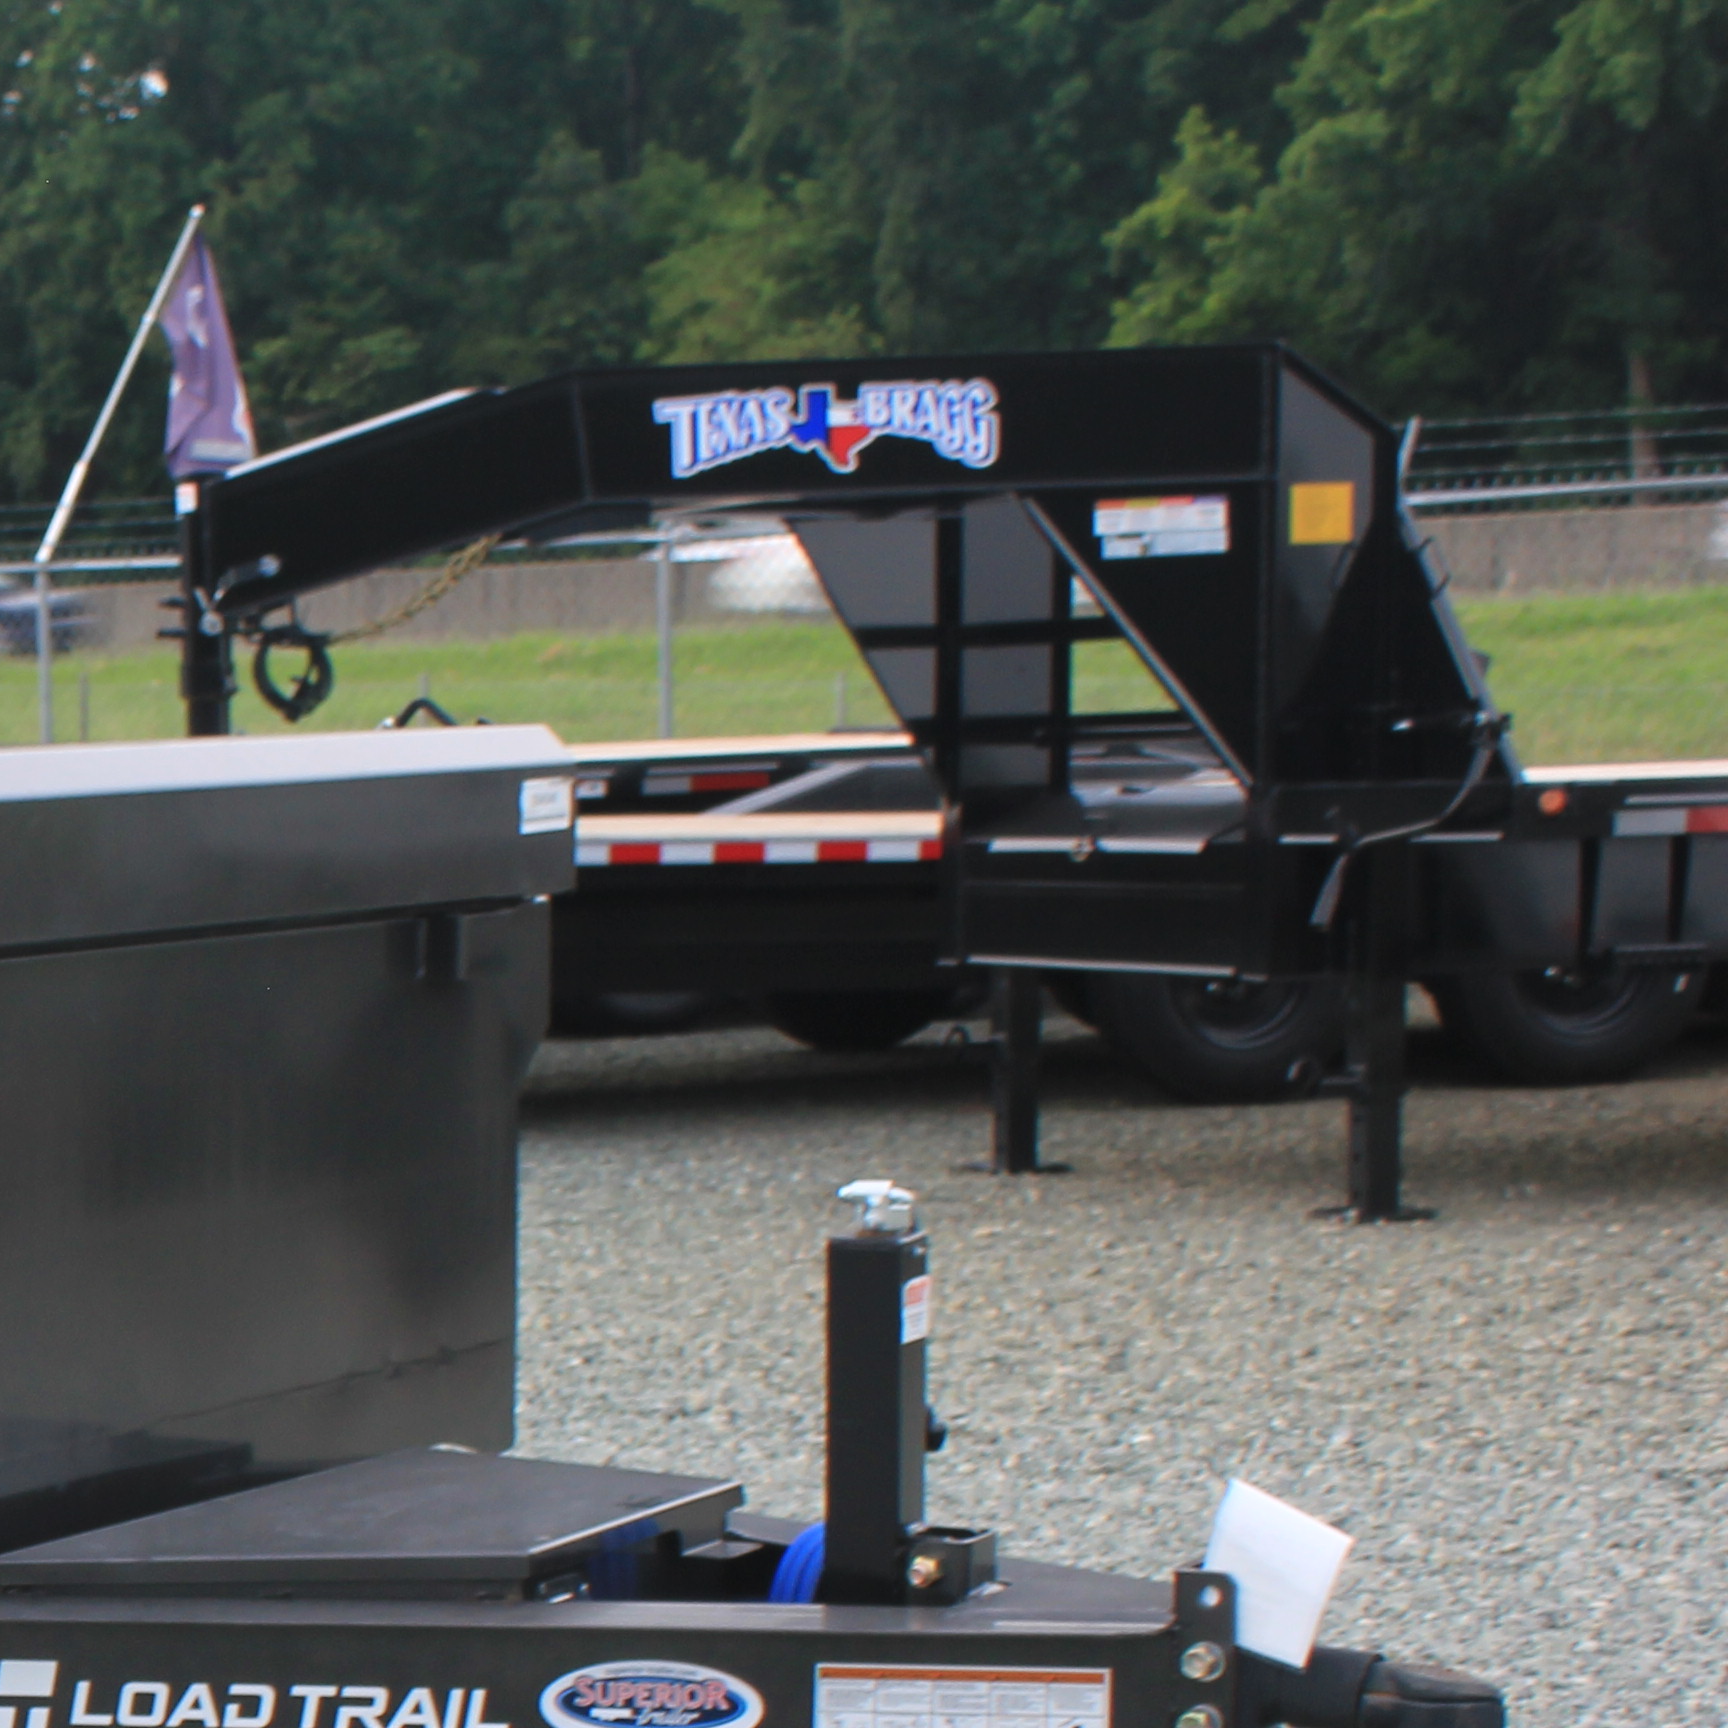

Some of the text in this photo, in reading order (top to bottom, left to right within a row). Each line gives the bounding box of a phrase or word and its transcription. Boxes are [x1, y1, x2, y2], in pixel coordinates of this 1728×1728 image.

[654, 379, 1000, 478] TEXAS BRAGG
[573, 1674, 731, 1711] SUPERIOR
